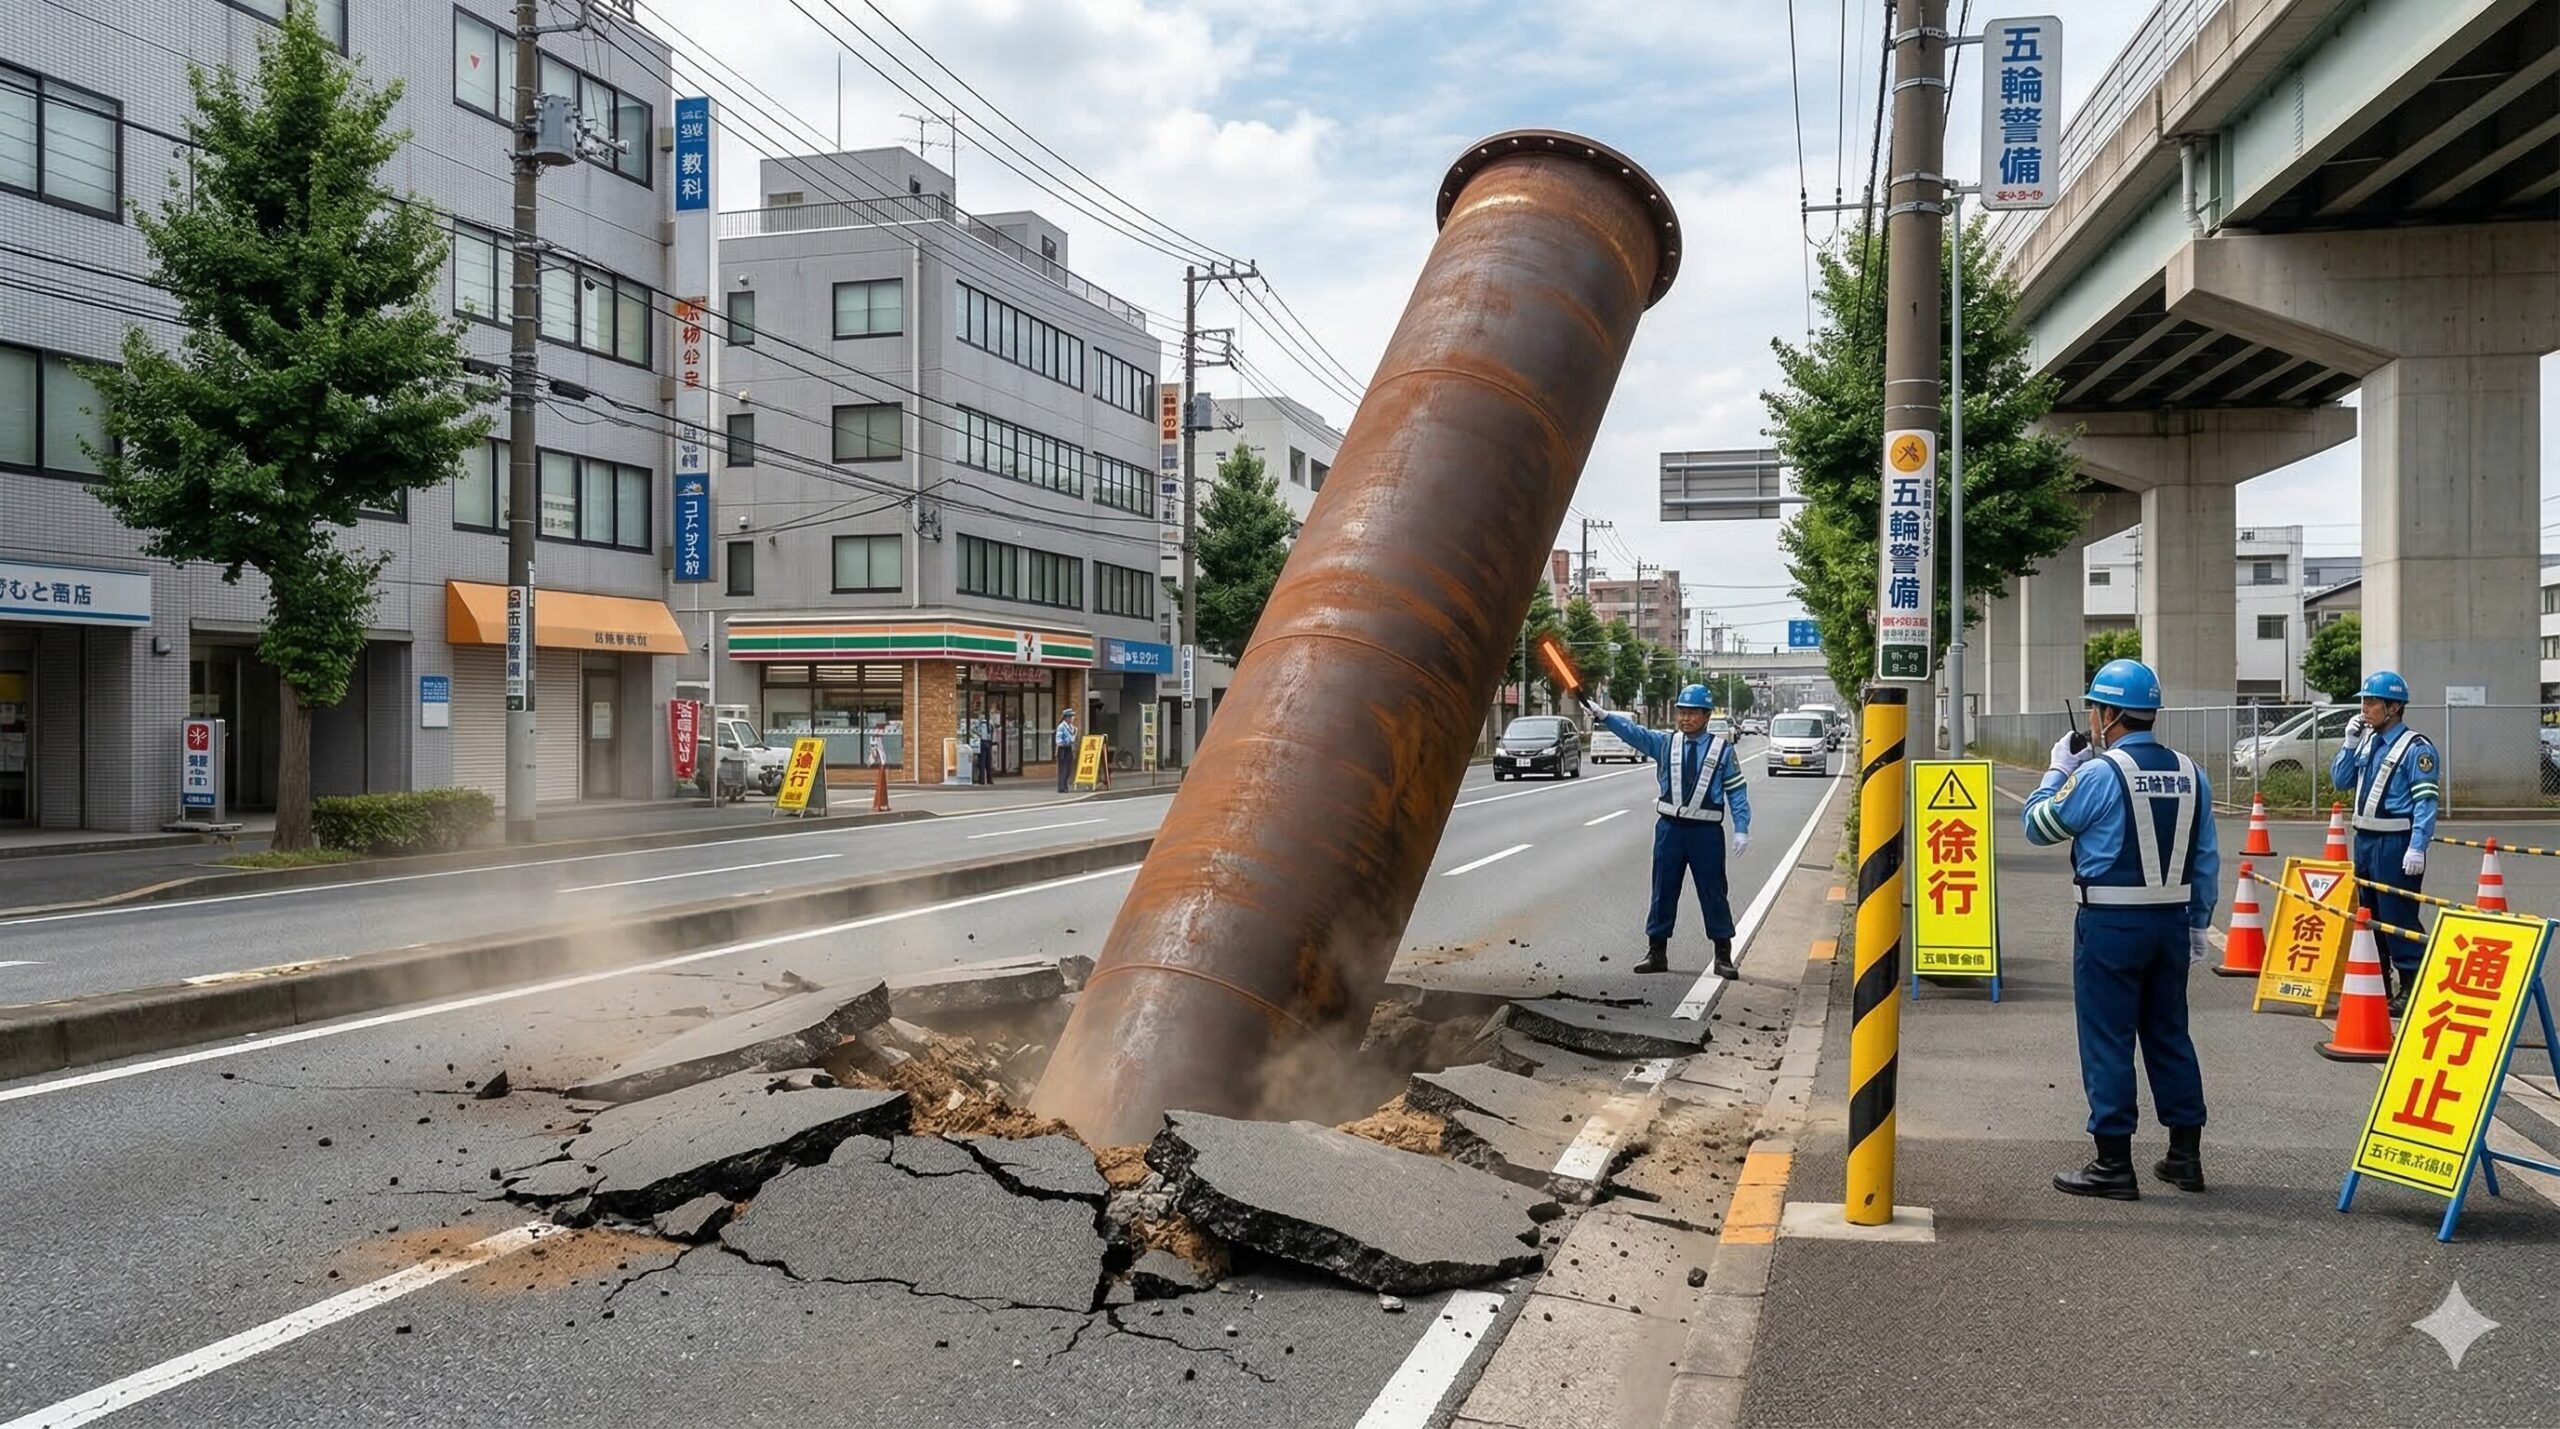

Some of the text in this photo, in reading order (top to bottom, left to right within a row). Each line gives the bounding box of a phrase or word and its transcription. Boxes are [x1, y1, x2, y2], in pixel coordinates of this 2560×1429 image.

[2000, 27, 2042, 185] 五輪警備
[1889, 478, 1921, 609] 五輪警備
[1927, 818, 1978, 915] 徐行
[2287, 913, 2326, 972] 徐行
[2392, 933, 2513, 1136] 通行止
